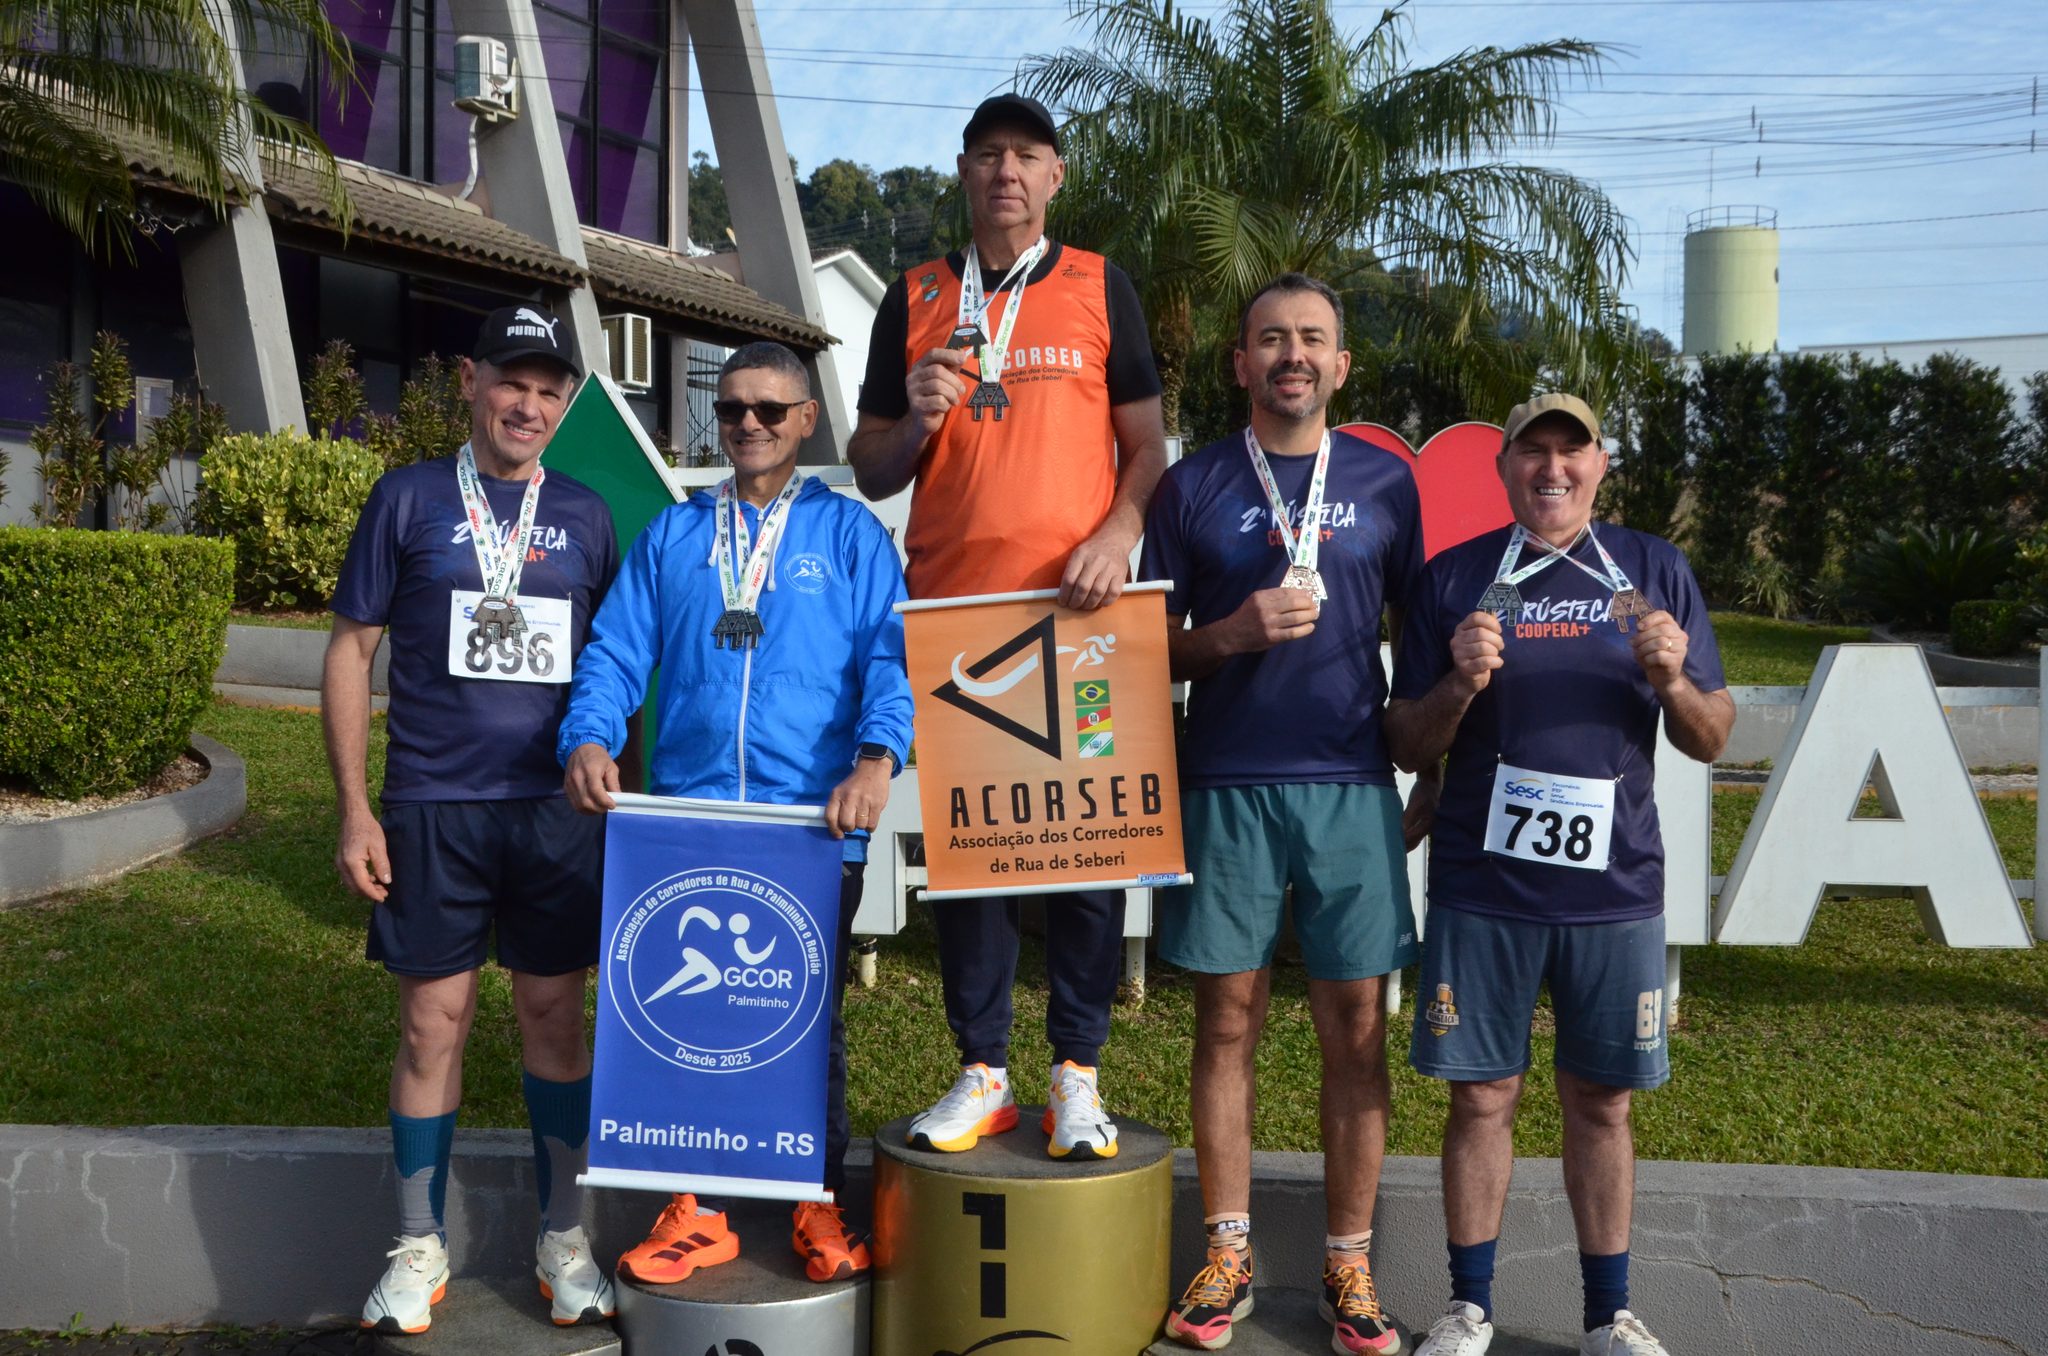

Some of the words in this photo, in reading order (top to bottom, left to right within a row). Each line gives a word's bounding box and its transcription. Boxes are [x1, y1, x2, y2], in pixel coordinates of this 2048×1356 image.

[507, 325, 545, 338] PUMA
[1002, 346, 1082, 370] CORSEB
[462, 465, 471, 491] CRESOL
[492, 562, 506, 594] CRESOL
[1516, 623, 1590, 639] COOPERA+
[465, 628, 555, 677] 896
[950, 773, 1162, 828] ACORSEB
[949, 830, 1034, 850] Associação
[1039, 827, 1068, 844] dos
[1072, 822, 1164, 842] Corredores
[1505, 803, 1593, 862] 738
[990, 858, 1010, 874] de
[1015, 856, 1044, 872] Rua
[1049, 853, 1069, 870] de
[1074, 851, 1126, 869] Seberi
[656, 875, 714, 901] Corredores
[715, 873, 729, 886] de
[730, 875, 751, 891] Rua
[751, 881, 765, 896] de
[644, 896, 660, 911] de
[764, 888, 808, 932] Palmitinho
[616, 907, 648, 962] Associação
[802, 929, 813, 938] e
[805, 939, 821, 976] Região
[723, 967, 793, 990] GCOR
[728, 994, 789, 1009] Palmitinho
[675, 1046, 717, 1067] Desde
[719, 1052, 752, 1067] 2025
[600, 1119, 749, 1153] Palmitinho
[776, 1131, 815, 1157] RS
[962, 1191, 1006, 1318] 1
